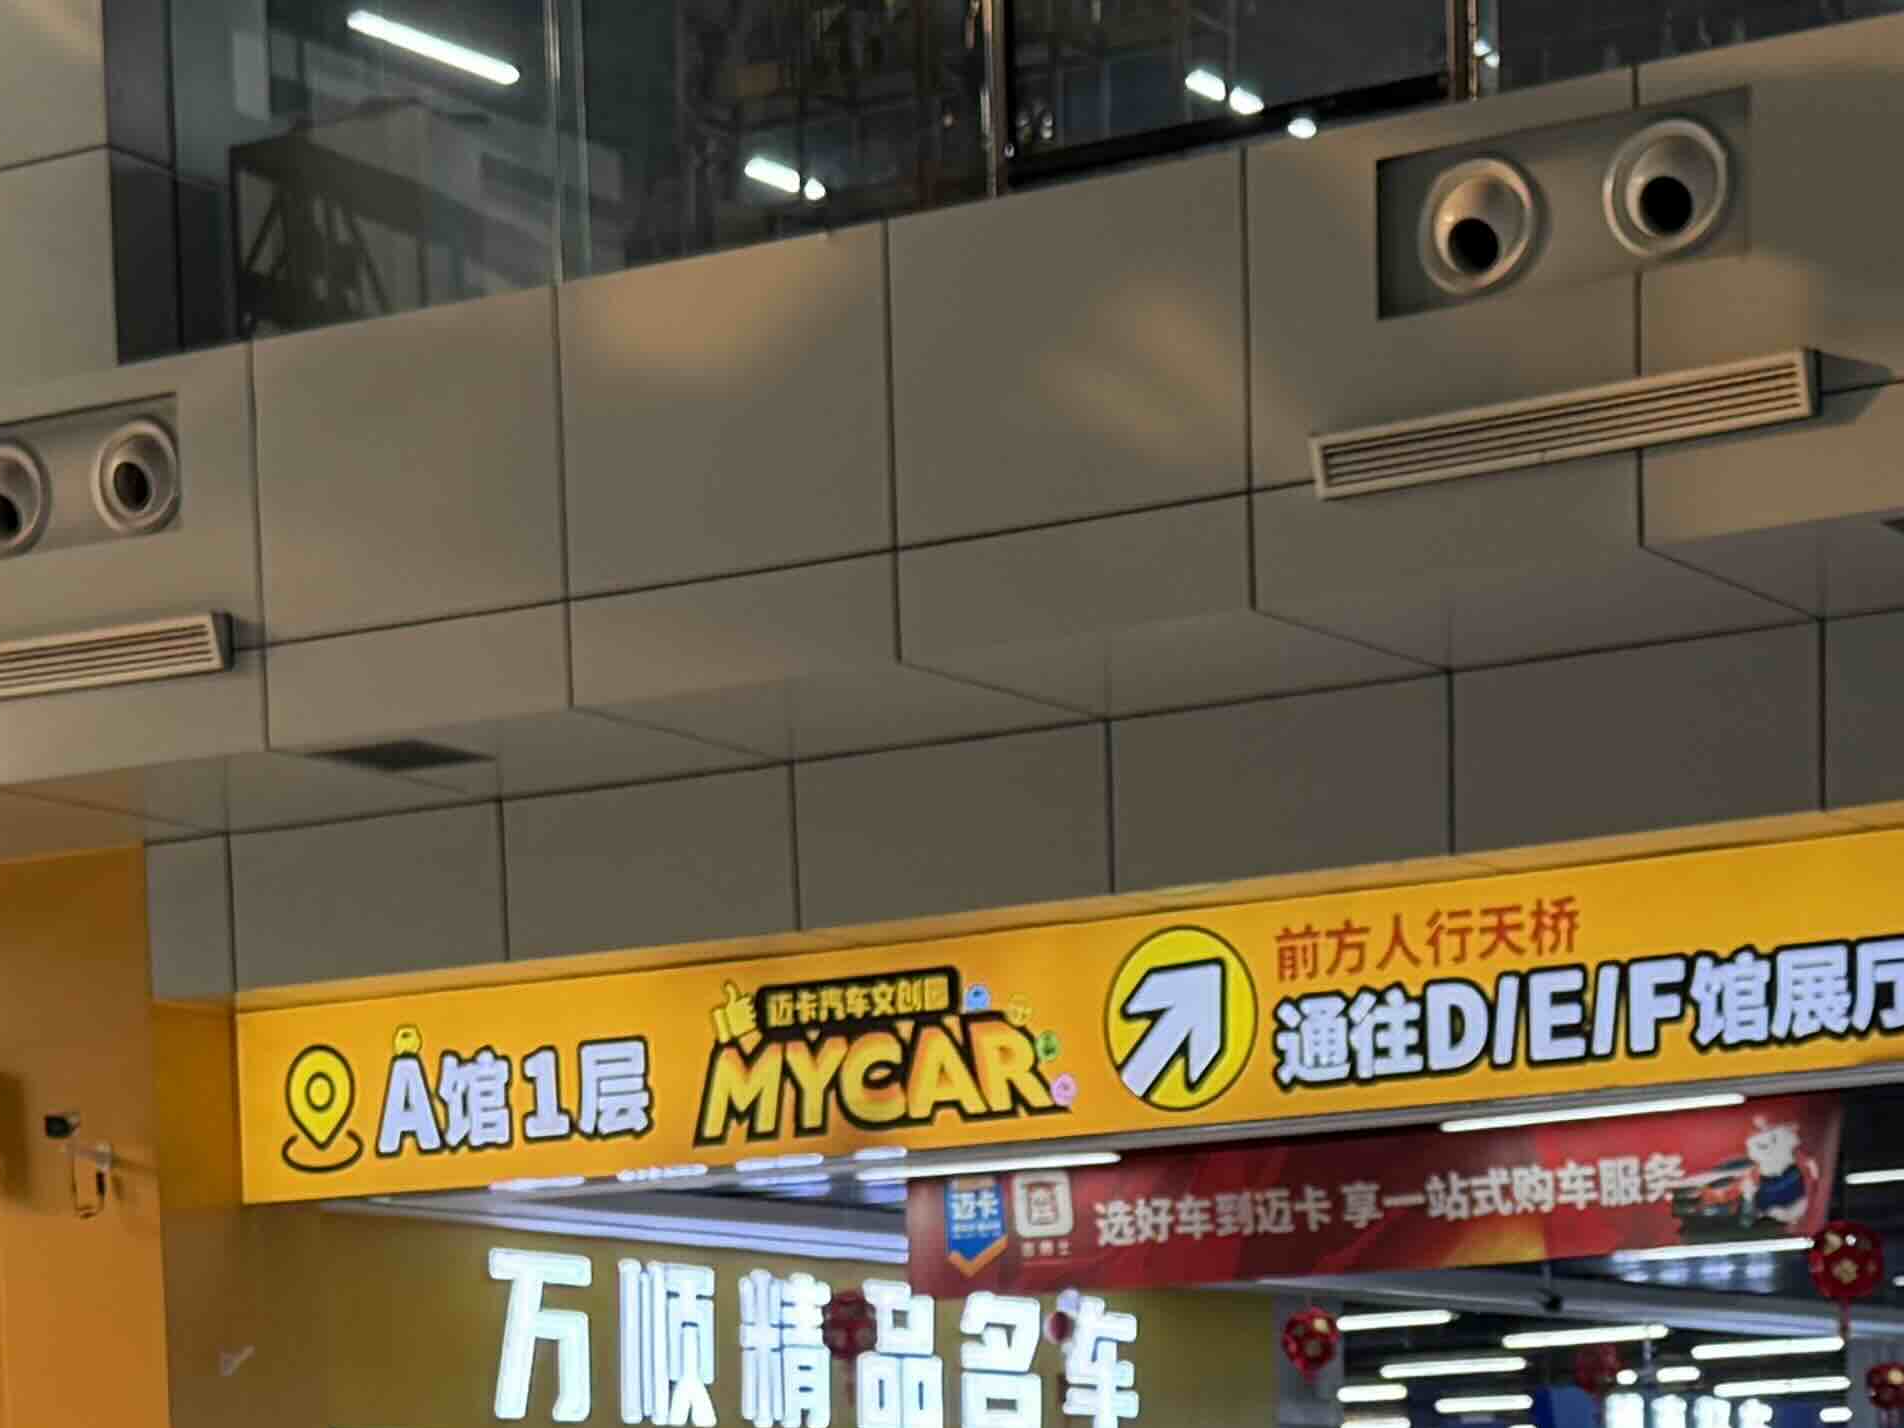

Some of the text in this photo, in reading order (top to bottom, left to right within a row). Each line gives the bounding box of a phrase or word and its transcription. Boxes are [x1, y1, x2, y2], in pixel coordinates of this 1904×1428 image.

[1274, 895, 1581, 982] 前方人行天桥
[765, 975, 950, 1028] 迈卡汽车文创园
[376, 1035, 653, 1155] A馆1层
[700, 1014, 1056, 1142] MYCAR
[1095, 1153, 1688, 1246] 选好车到迈卡 享一站式购车服务
